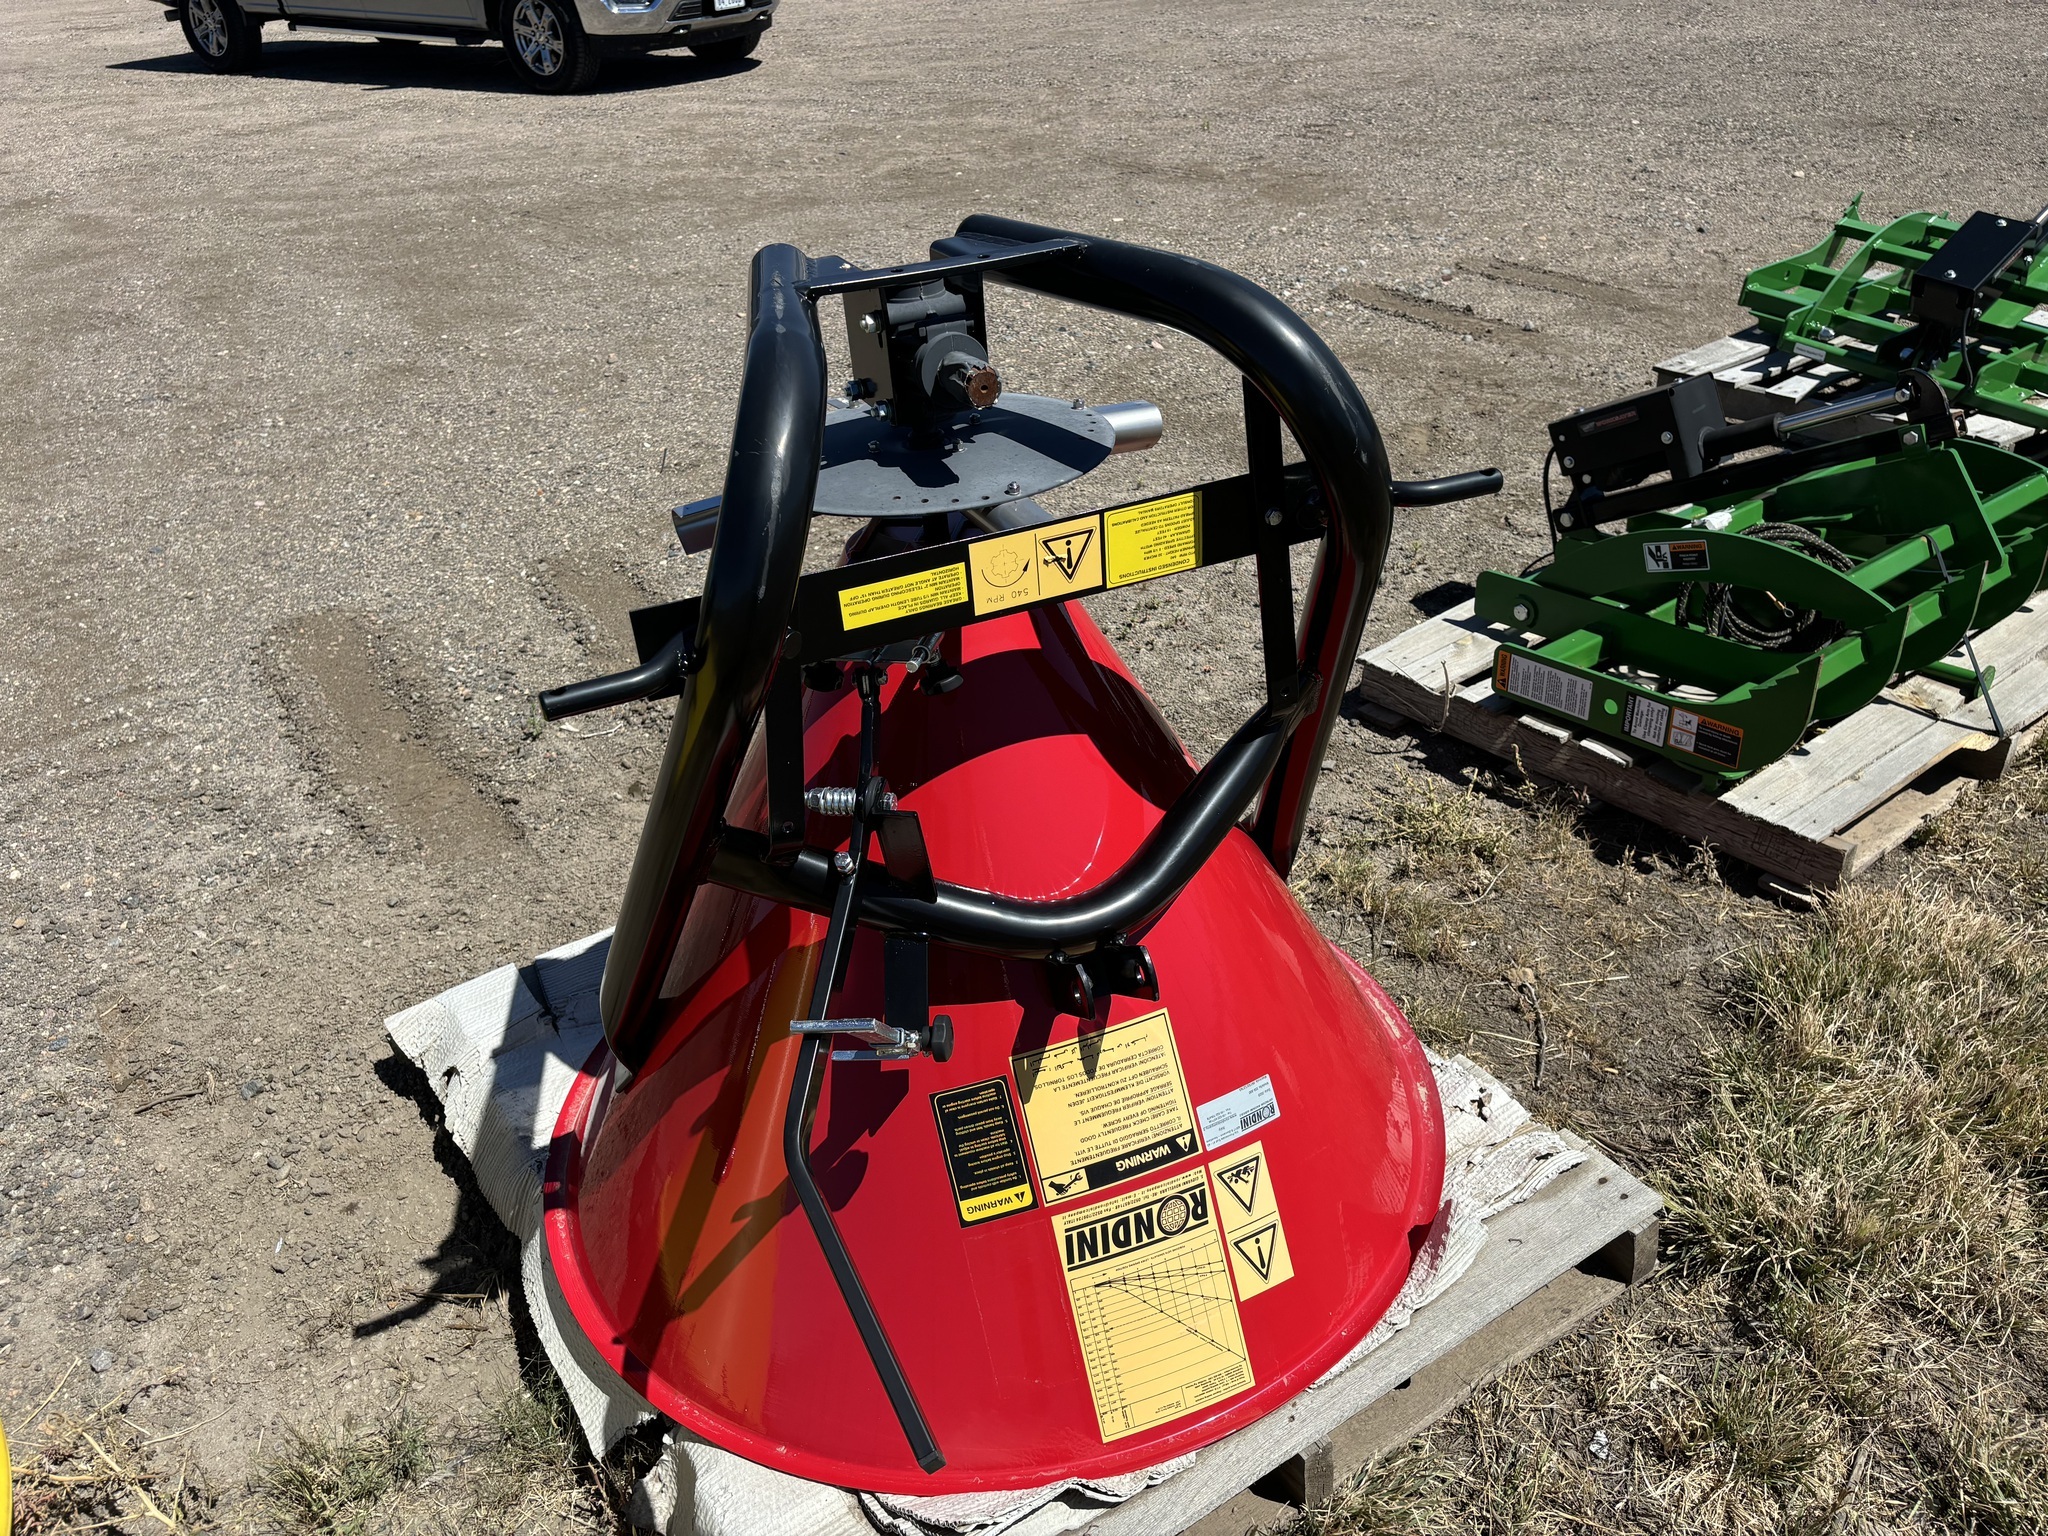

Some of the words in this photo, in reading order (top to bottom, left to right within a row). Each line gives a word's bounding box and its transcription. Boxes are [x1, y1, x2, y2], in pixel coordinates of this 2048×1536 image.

[1111, 517, 1139, 527] CALIBRATIONS
[1157, 557, 1189, 570] CONDENSED
[930, 566, 959, 576] HORIZONTAL
[938, 571, 959, 579] OPERATE
[1118, 565, 1157, 579] INSTRUCTIONS
[914, 577, 930, 585] ANGLE
[934, 581, 960, 591] OPERATION
[937, 576, 960, 585] MAINTAIN
[880, 584, 903, 593] GREATER
[890, 584, 923, 596] TELESCOPING
[939, 586, 961, 595] MAINTAIN
[1010, 587, 1028, 599] 540
[843, 597, 870, 607] OPERATION
[871, 592, 889, 601] DURING
[919, 596, 939, 605] GUARDS
[943, 596, 962, 604] GREASE
[985, 593, 1005, 605] RPM
[867, 603, 889, 612] OVERLAP
[889, 598, 909, 607] LENGTH
[918, 600, 942, 610] BEARINGS
[848, 608, 867, 617] DURING
[1623, 694, 1634, 732] IMPORTANT
[1706, 719, 1740, 736] WARNING
[1137, 1044, 1164, 1057] CORRECTA
[1105, 1053, 1137, 1068] CERRADURA
[1077, 1066, 1097, 1077] TODOS
[1097, 1063, 1105, 1071] DE
[1110, 1061, 1137, 1074] VERIFICAR
[1137, 1062, 1168, 1077] SCHRAUBEN
[1065, 1072, 1078, 1081] LOS
[1143, 1069, 1169, 1082] VORSICHT!
[1134, 1078, 1144, 1086] DIE
[1149, 1080, 1172, 1092] SERRAGE
[1073, 1079, 1119, 1098] KONTROLLIEREN.
[1085, 1081, 1135, 1102] KLEMMFESTIGKEIT
[1144, 1087, 1174, 1102] ATTENTION!
[1066, 1097, 1085, 1108] JEDEN
[1089, 1100, 1112, 1113] CHAQUE
[1146, 1097, 1177, 1113] TIGHTENING
[1078, 1108, 1089, 1116] VIS.
[1138, 1108, 1147, 1116] OF
[1149, 1110, 1165, 1119] CARE!
[1165, 1105, 1178, 1114] TAKE
[1121, 1111, 1139, 1121] EVERY
[1131, 1115, 1150, 1126] CHECK
[1238, 1102, 1276, 1131] RONDINI
[1100, 1117, 1122, 1129] SCREW.
[1149, 1117, 1176, 1131] CORRETTO
[1096, 1121, 1131, 1138] FREQUENTLY
[1118, 1127, 1149, 1142] SERRAGGIO
[1150, 1123, 1183, 1138] ATTENZIONE!
[1079, 1133, 1096, 1144] GOOD
[1120, 1134, 1150, 1149] VERIFICARE
[1093, 1139, 1111, 1150] TUTTE
[1069, 1144, 1120, 1166] FREQUENTEMENTE
[1073, 1148, 1085, 1156] VITI.
[1114, 1143, 1171, 1172] WARNING
[965, 1194, 1013, 1215] WARNING
[1064, 1188, 1209, 1266] RONDINI
